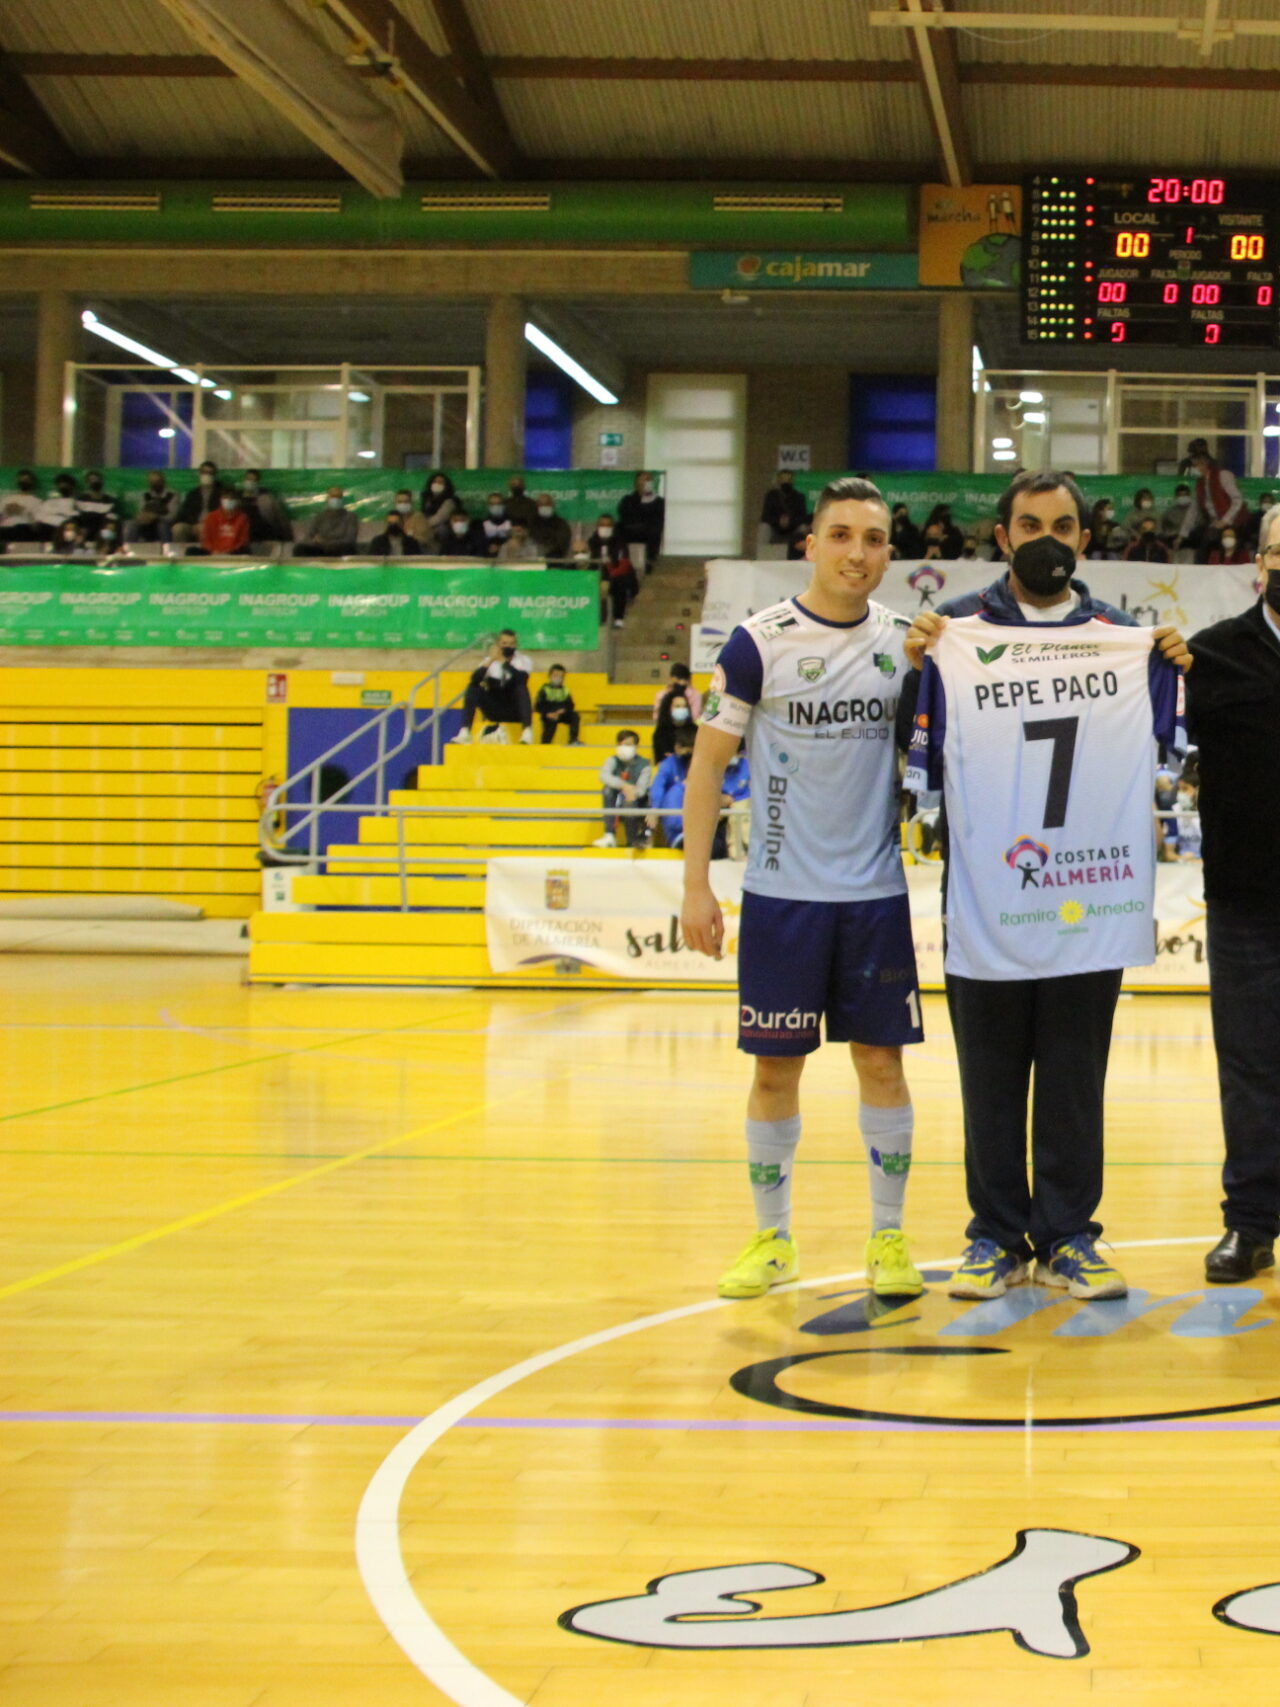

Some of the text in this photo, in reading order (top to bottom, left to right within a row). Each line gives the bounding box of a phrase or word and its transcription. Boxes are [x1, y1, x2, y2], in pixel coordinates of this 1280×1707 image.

[1148, 178, 1225, 204] 20:00
[1114, 212, 1160, 225] LOCAL
[1116, 232, 1150, 258] 00
[1231, 235, 1264, 260] 00
[766, 256, 870, 282] cajamar
[1098, 282, 1126, 302] 00
[1164, 283, 1178, 304] 0
[1192, 284, 1220, 304] 00
[1257, 285, 1272, 306] 0
[0, 592, 53, 605] GROUP
[60, 593, 141, 606] INAGROUP
[149, 593, 230, 606] INAGROUP
[239, 594, 320, 607] INAGROUP
[328, 595, 410, 608] INAGROUP
[418, 595, 499, 608] INAGROUP
[508, 596, 590, 610] INAGROUP
[1011, 643, 1031, 656] El
[1011, 651, 1101, 663] SEMILLEROS
[975, 670, 1118, 710] PEPE PACO
[788, 698, 900, 725] INAGROU
[814, 727, 889, 740] EL EJIDO
[1023, 715, 1080, 830] 7
[765, 775, 788, 871] Bioline
[1055, 845, 1131, 865] COSTA DE
[1042, 860, 1134, 889] ALMERÍA
[999, 898, 1145, 926] Ramiro Arnedo
[509, 917, 603, 934] DIPUTACIÓN
[512, 933, 600, 949] DE ALMERÍA
[740, 1004, 817, 1029] Durán
